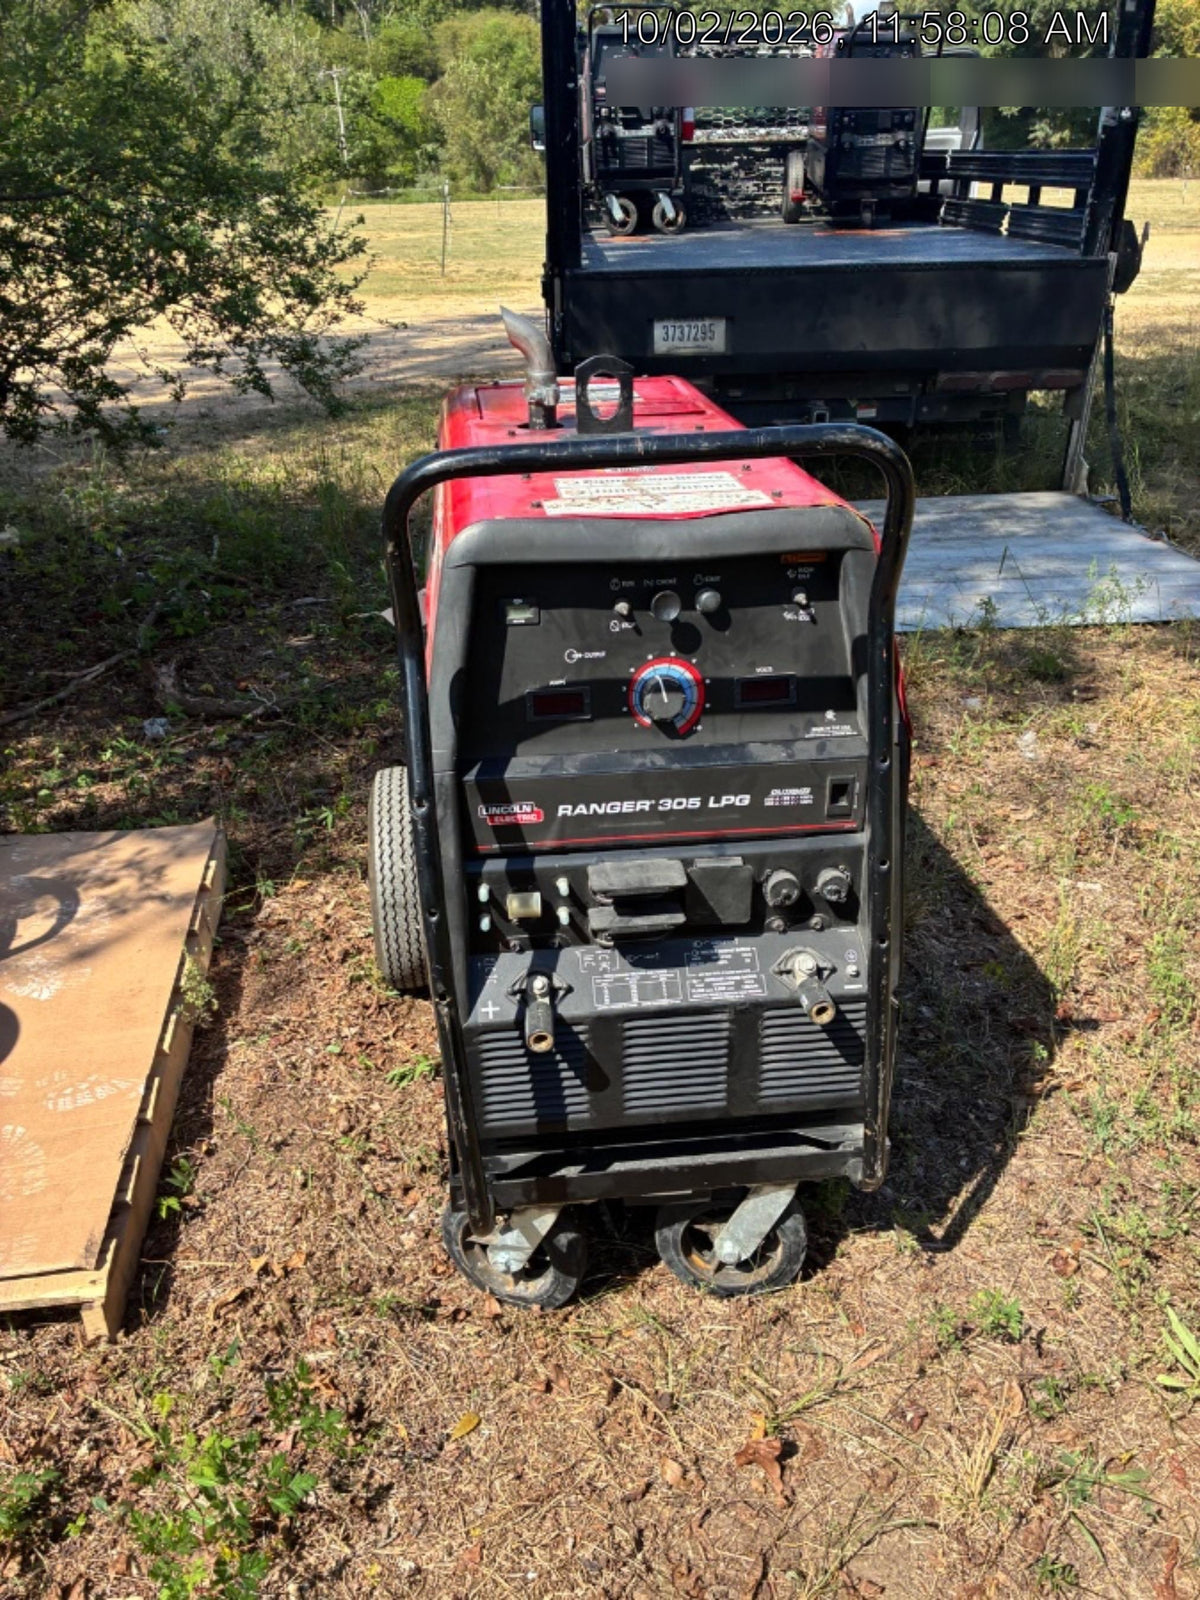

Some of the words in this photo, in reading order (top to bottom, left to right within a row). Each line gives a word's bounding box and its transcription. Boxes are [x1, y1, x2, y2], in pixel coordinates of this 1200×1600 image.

[662, 323, 716, 343] 3737295
[482, 803, 532, 815] LINCOLN
[657, 797, 702, 812] 305
[708, 794, 751, 808] LPG
[494, 813, 538, 822] ELECTRIC
